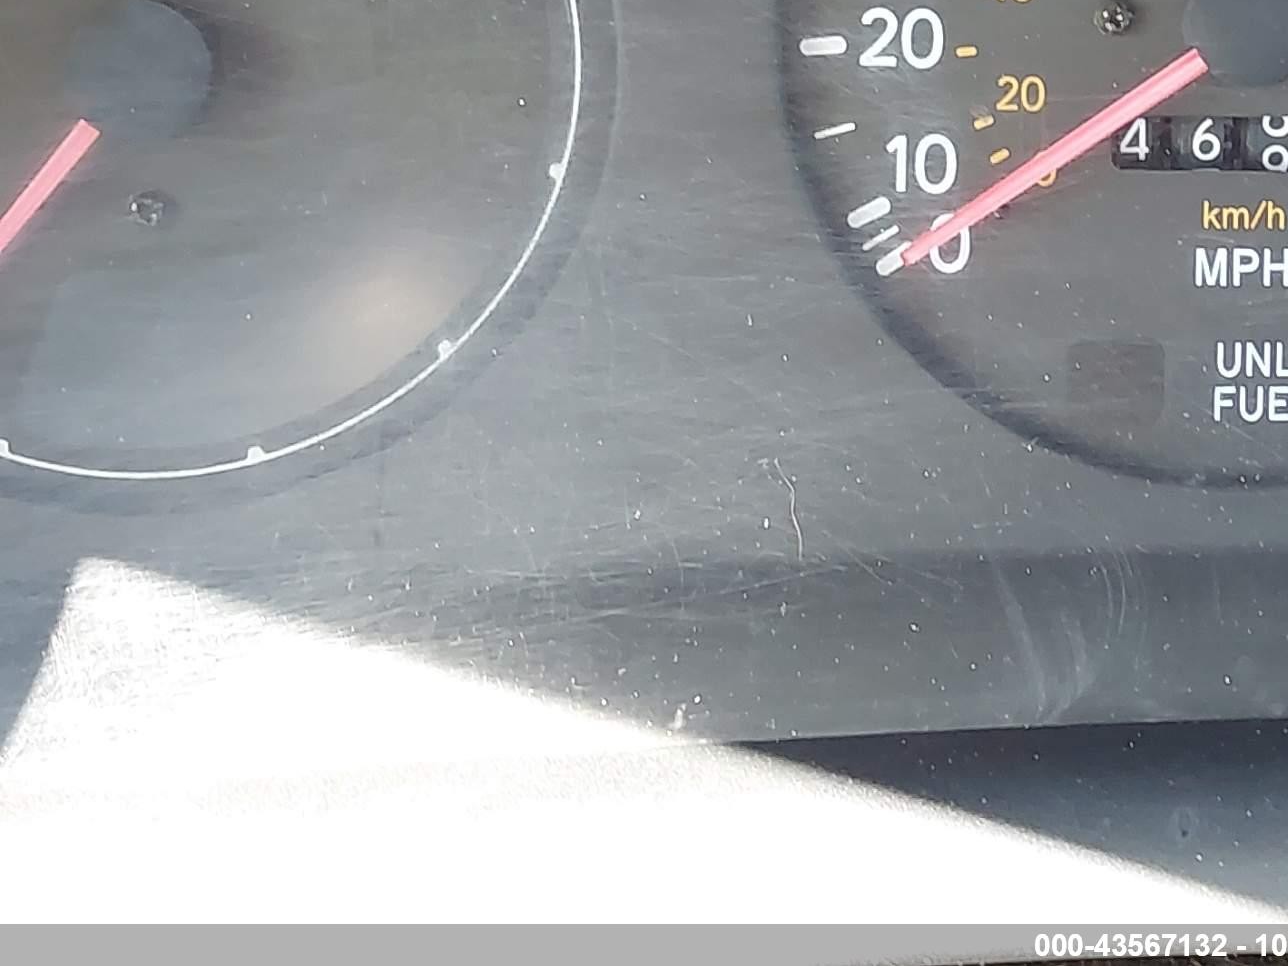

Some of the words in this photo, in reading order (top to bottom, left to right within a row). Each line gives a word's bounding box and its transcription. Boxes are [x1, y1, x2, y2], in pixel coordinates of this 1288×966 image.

[858, 6, 944, 70] 20
[995, 74, 1047, 113] 20
[885, 133, 958, 195] 10
[1201, 201, 1286, 229] km/h
